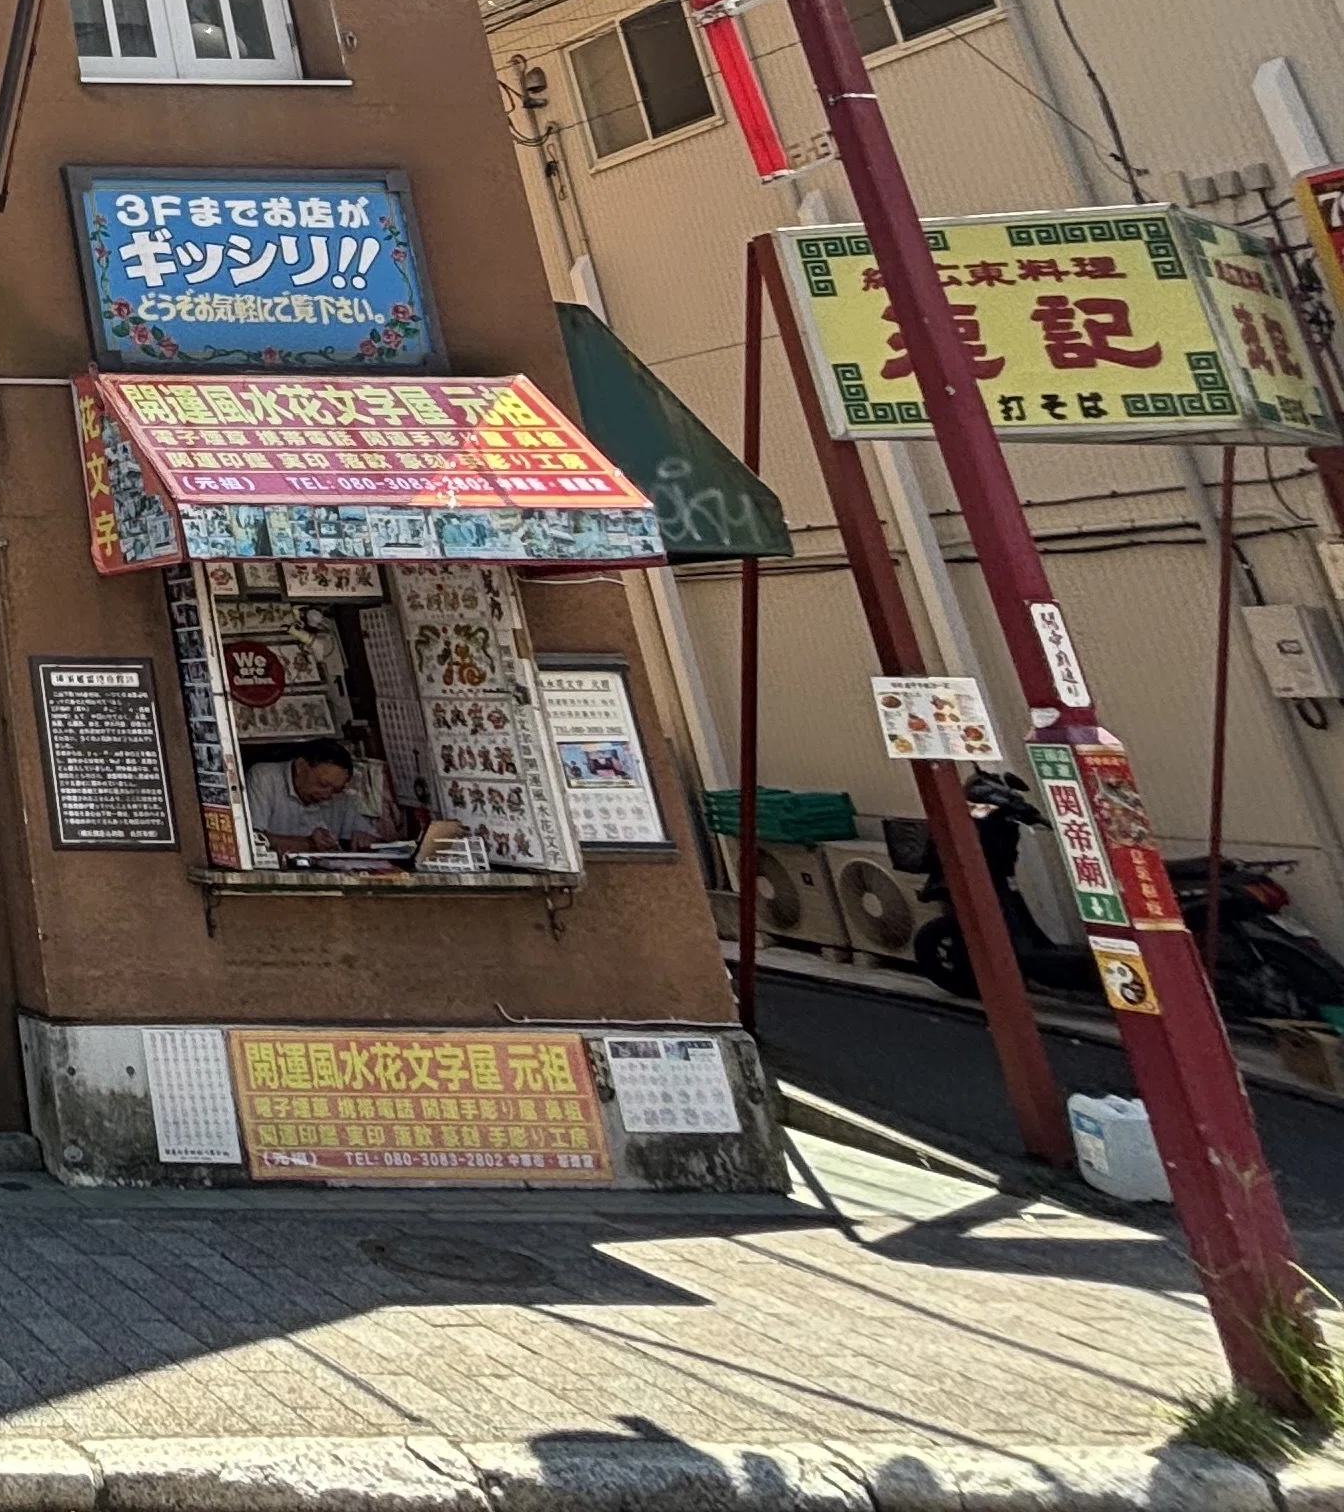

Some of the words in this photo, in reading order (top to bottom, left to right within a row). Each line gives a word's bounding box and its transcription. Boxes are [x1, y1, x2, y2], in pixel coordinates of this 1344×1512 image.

[116, 194, 370, 228] 3Fまでお店が
[137, 289, 385, 324] どうぞお気軽にご覧下さい。
[440, 386, 547, 427] 元祖
[80, 396, 118, 556] 花文字
[233, 652, 267, 668] We
[1049, 785, 1106, 888] 関帝廟
[508, 1044, 577, 1091] 元祖
[384, 1152, 503, 1168] 080-3083-2802
